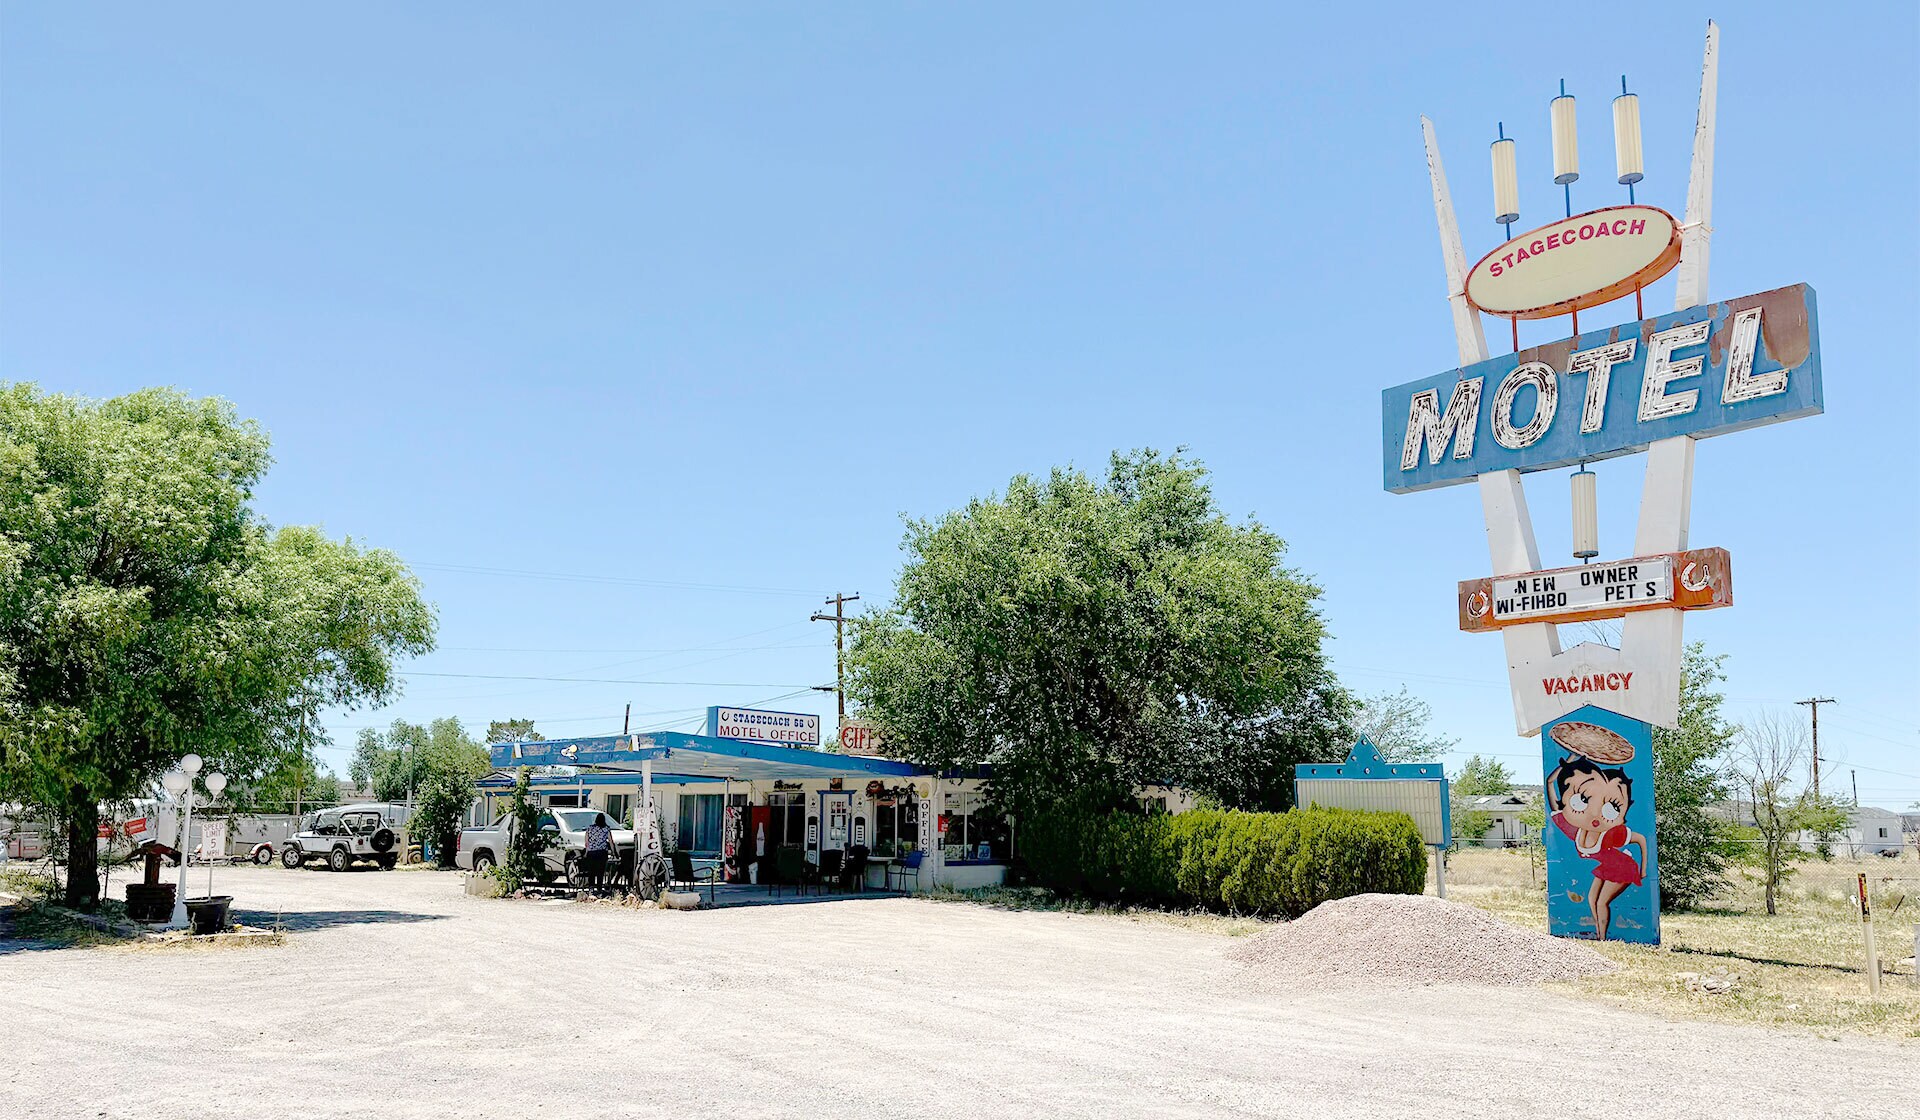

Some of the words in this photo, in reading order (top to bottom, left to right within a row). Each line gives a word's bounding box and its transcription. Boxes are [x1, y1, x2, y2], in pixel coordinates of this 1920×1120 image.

[1489, 219, 1646, 277] STAGECOACH
[1400, 306, 1790, 472] MOTEL
[1580, 565, 1639, 586] OWNER
[1542, 671, 1633, 695] VACANCY
[733, 713, 790, 727] STAGECOACH
[719, 725, 764, 739] MOTEL
[770, 729, 816, 742] OFFICE
[203, 822, 224, 831] SPEED
[205, 830, 221, 838] LIMIT
[921, 802, 929, 855] OFFICE
[210, 838, 217, 849] 5
